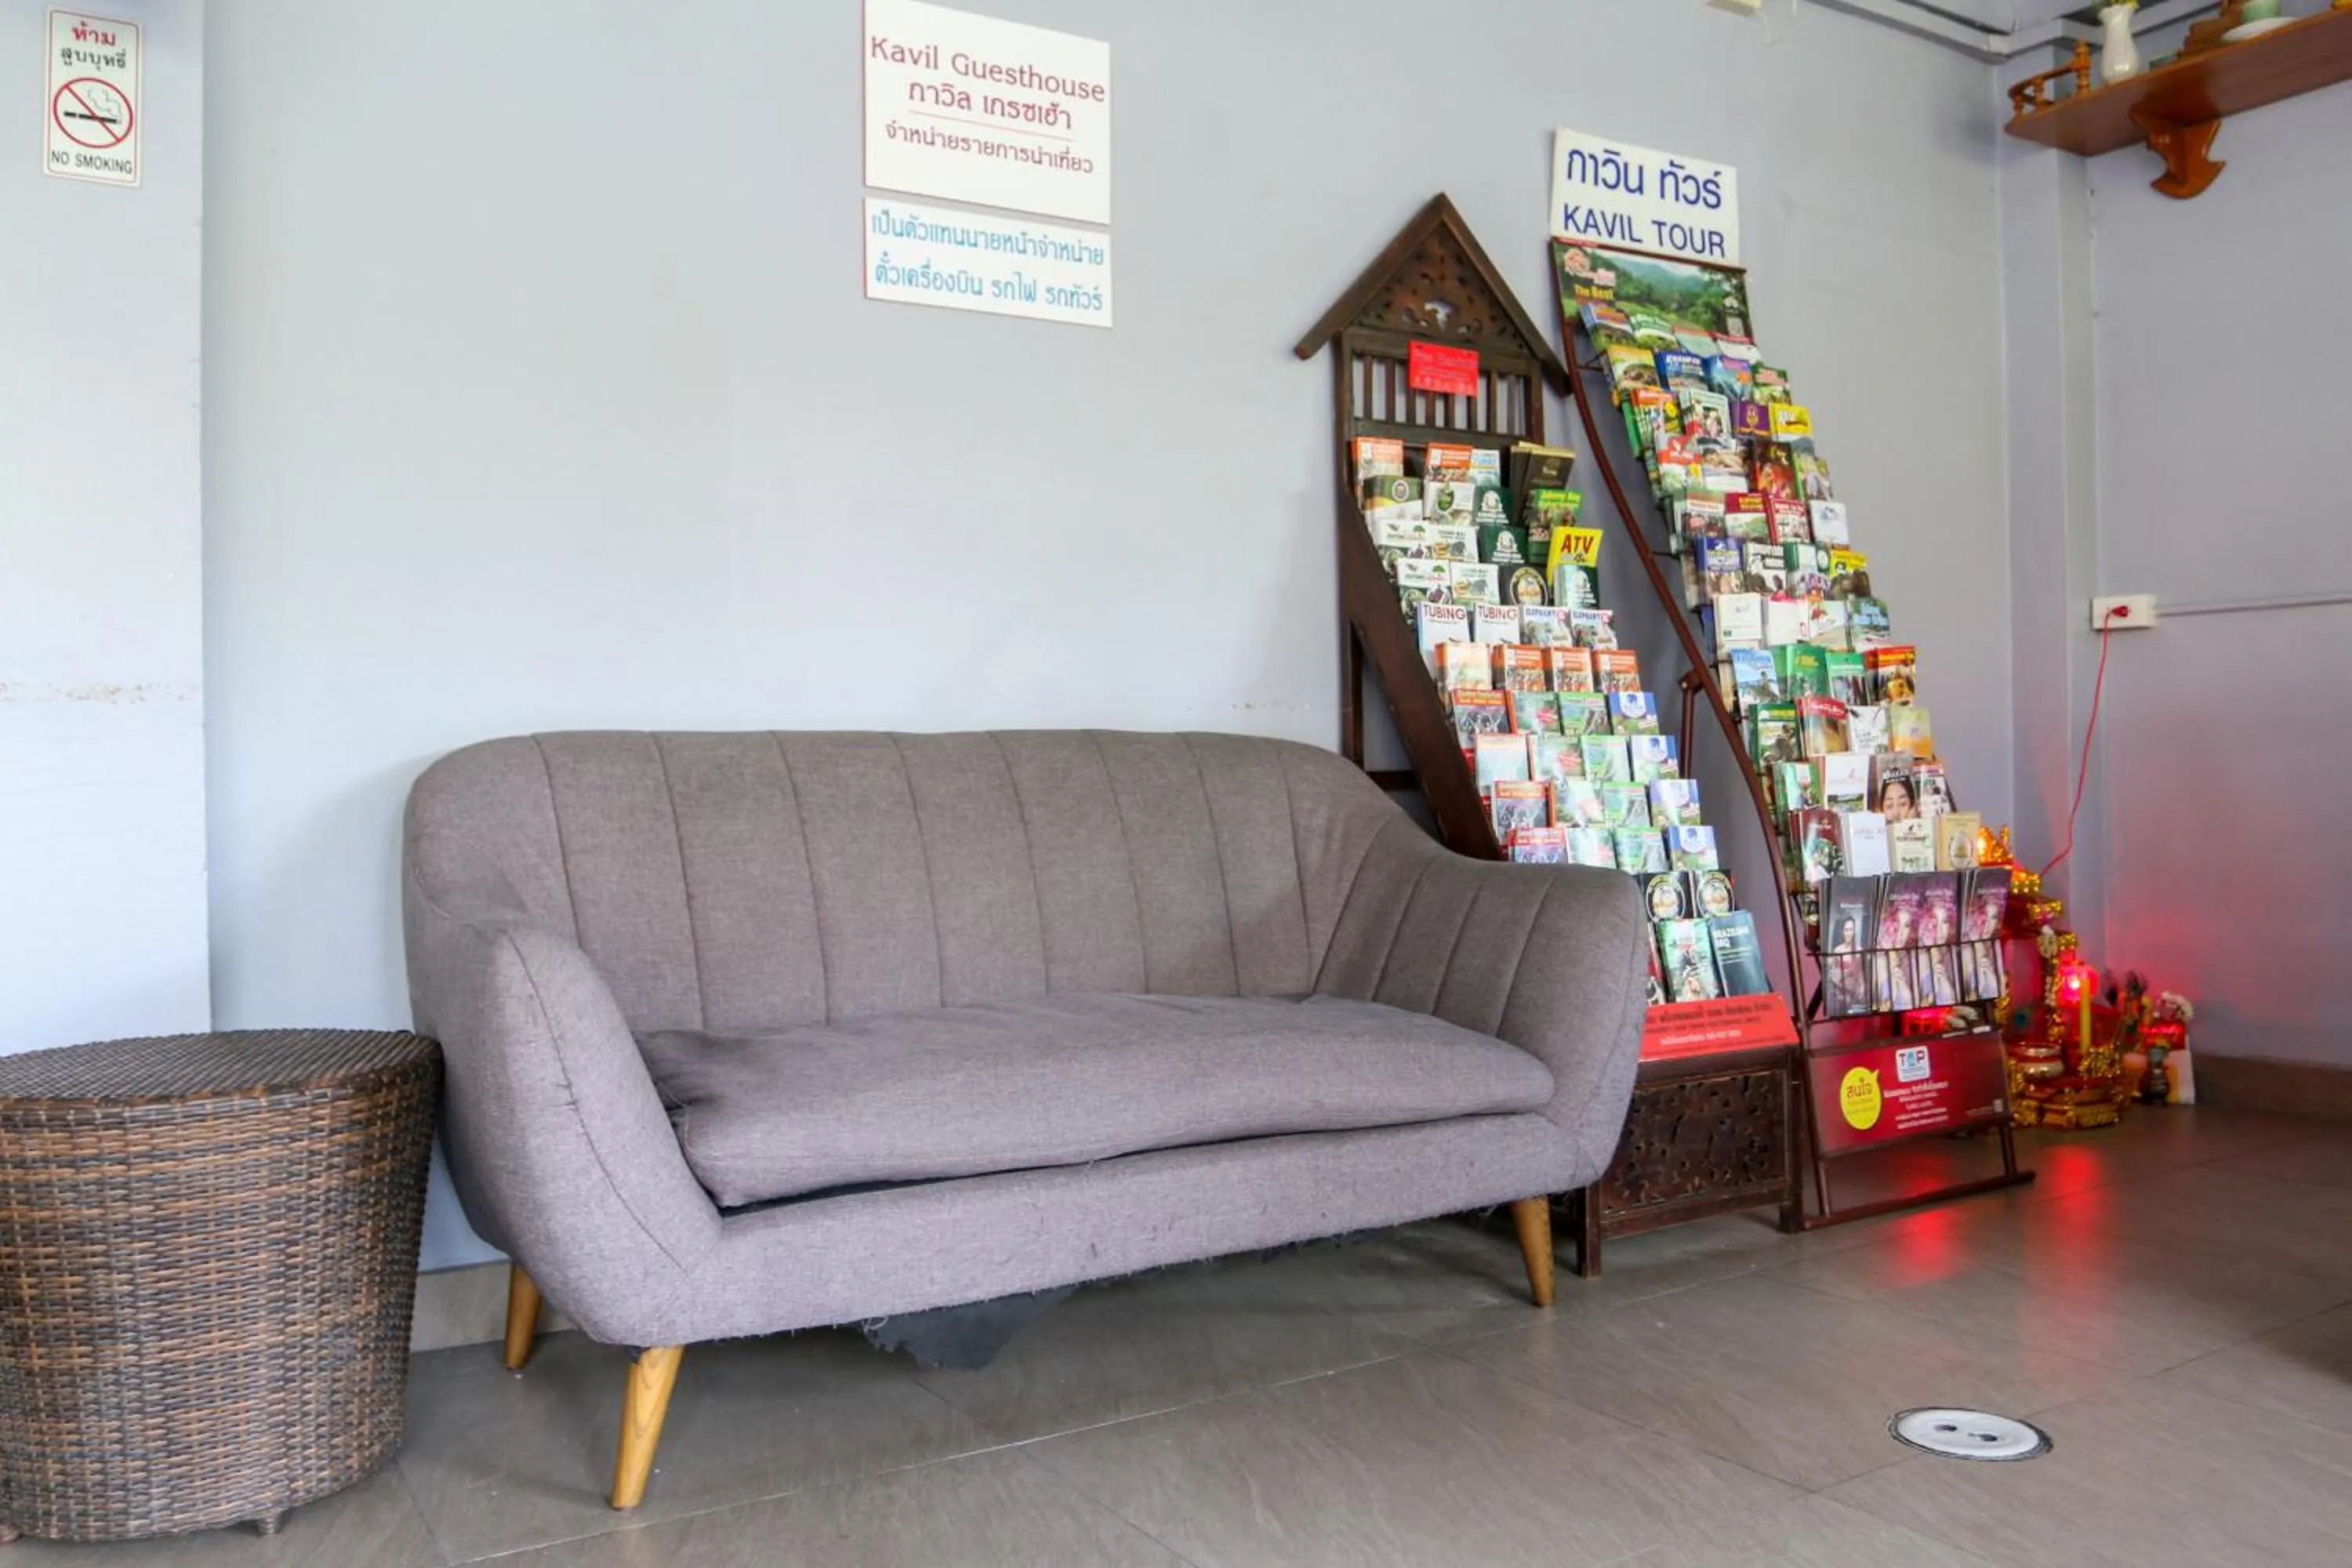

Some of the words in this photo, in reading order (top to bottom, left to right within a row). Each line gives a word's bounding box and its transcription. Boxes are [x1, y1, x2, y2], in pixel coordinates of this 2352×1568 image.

[71, 20, 116, 46] ห้าม
[870, 35, 939, 70] Kavil
[951, 53, 1105, 103] Guesthouse
[908, 81, 972, 111] กาวิล
[51, 150, 70, 165] NO
[74, 153, 132, 175] SMOKING
[1567, 148, 1644, 196] กาวิน
[1660, 159, 1722, 209] ทัวร์
[1563, 202, 1643, 244] KAVIL
[1651, 219, 1726, 259] TOUR
[991, 271, 1037, 303] รถไฟ
[1045, 283, 1103, 312] รถทัวร์
[1560, 534, 1595, 554] ATV
[1423, 604, 1466, 620] TUBING
[1478, 605, 1518, 620] TUBING
